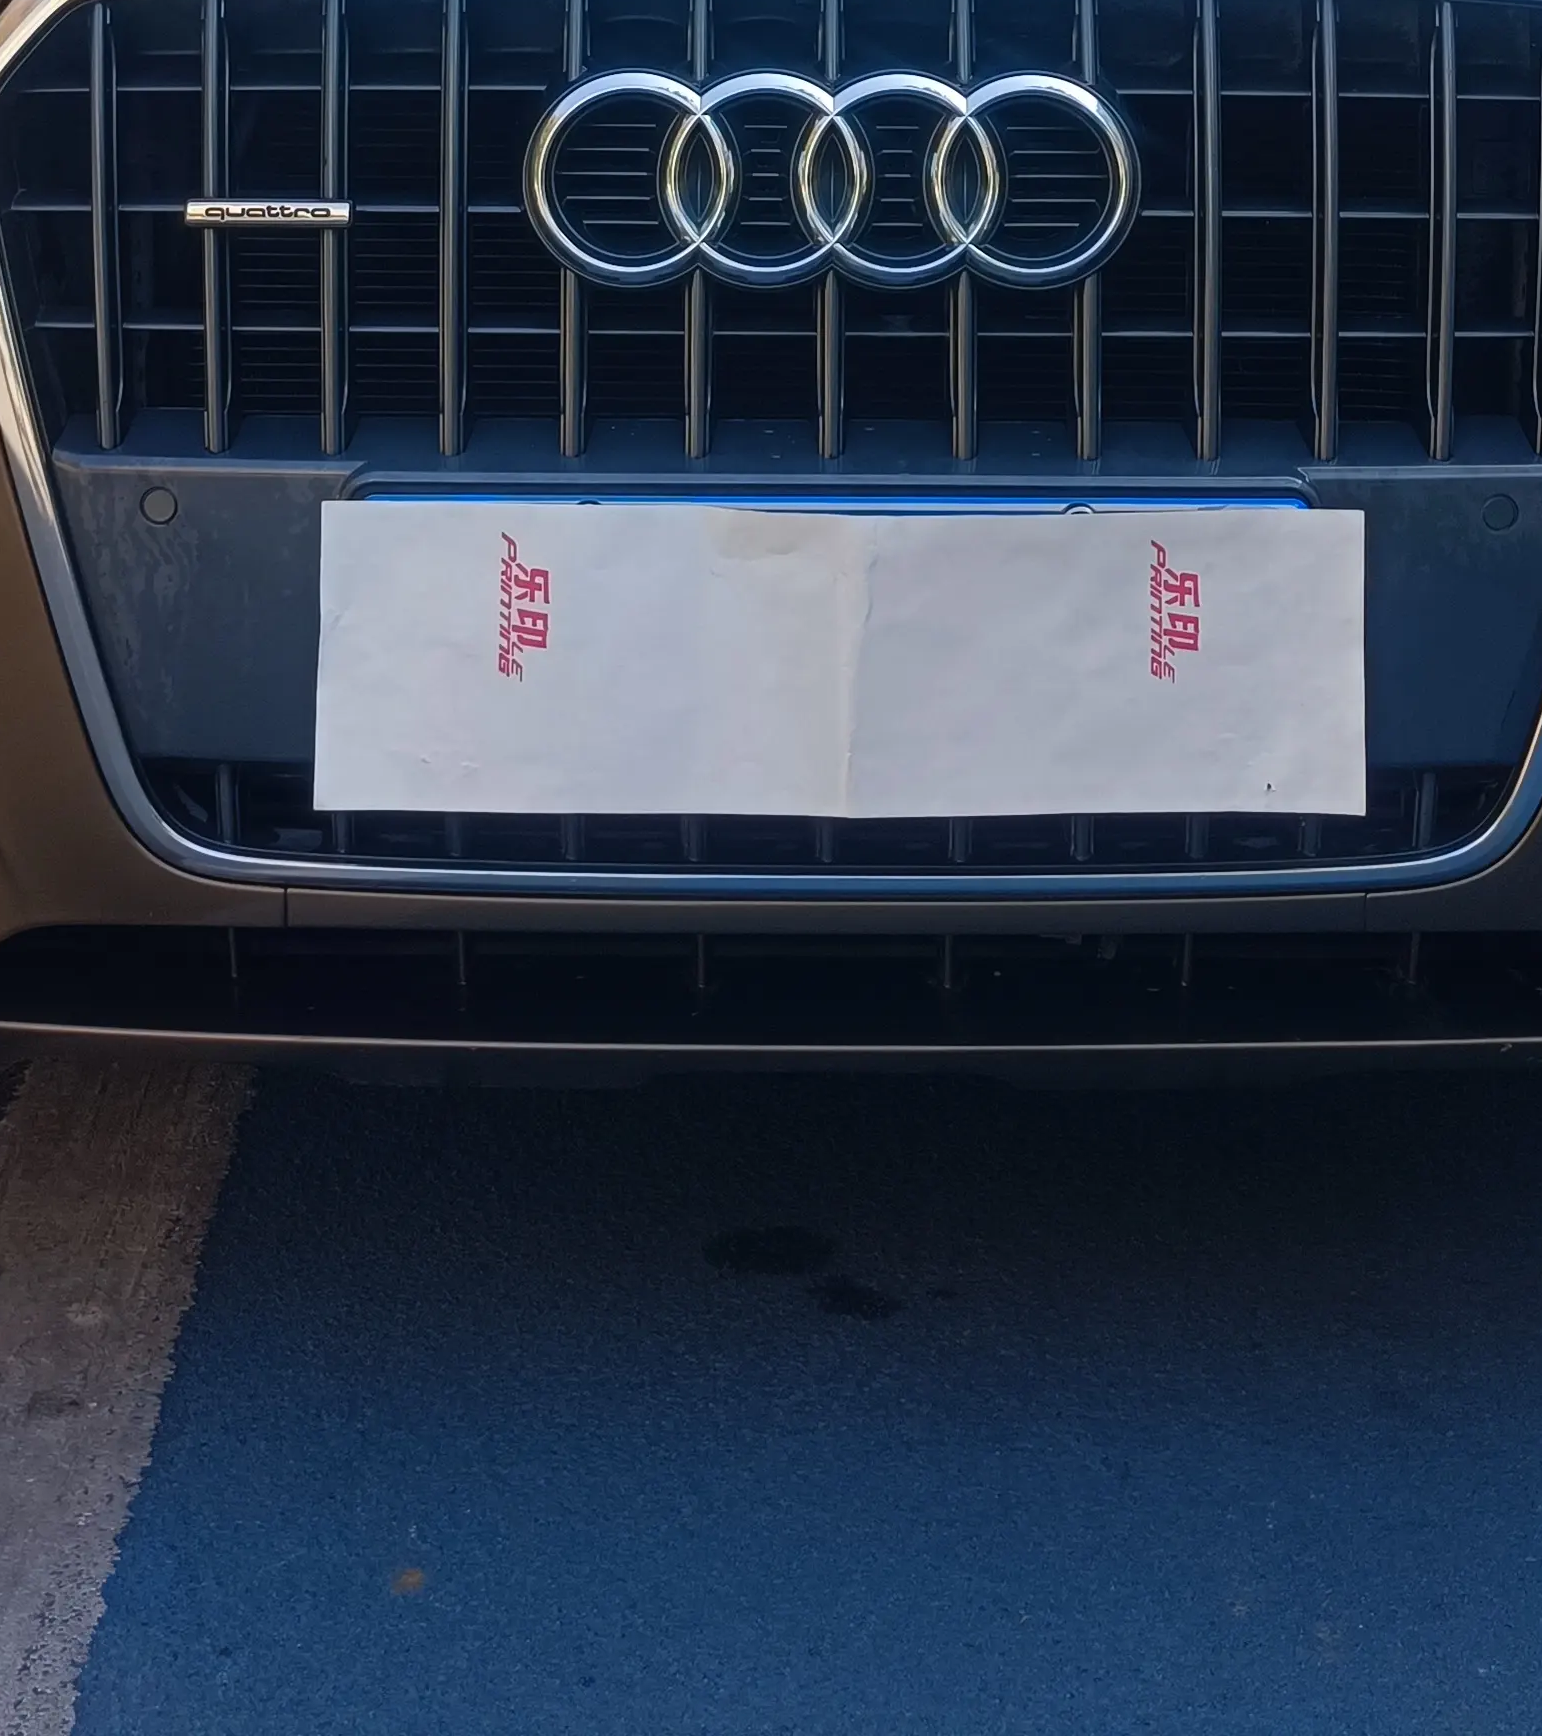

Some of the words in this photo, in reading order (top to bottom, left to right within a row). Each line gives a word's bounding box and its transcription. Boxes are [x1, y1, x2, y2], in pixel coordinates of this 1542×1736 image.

[204, 205, 332, 221] quattro
[498, 532, 517, 677] PRINTING
[512, 563, 551, 649] 乐印
[1150, 540, 1168, 680] PRINTING
[1163, 568, 1200, 652] 乐印
